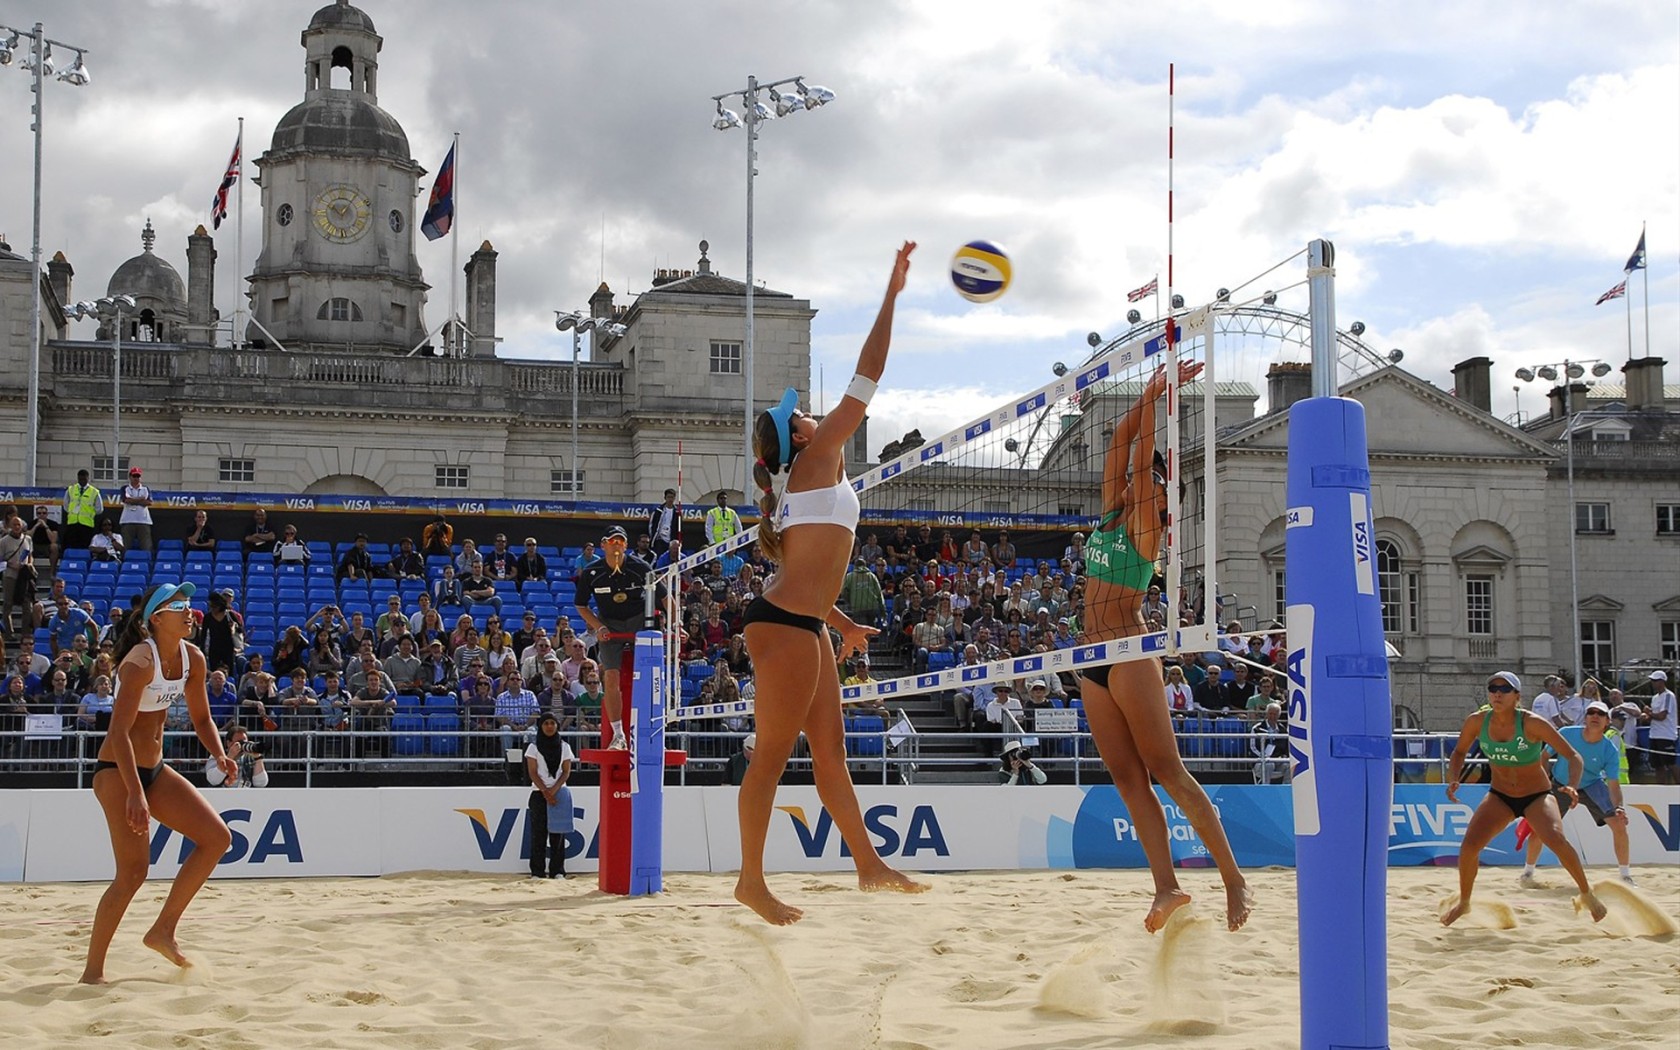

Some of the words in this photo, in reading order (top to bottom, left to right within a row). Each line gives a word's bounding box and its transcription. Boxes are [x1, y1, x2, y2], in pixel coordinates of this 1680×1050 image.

[1087, 370, 1099, 382] VISA
[0, 491, 14, 502] SA
[166, 496, 197, 507] VISA
[286, 498, 315, 510] VISA
[342, 499, 371, 511] VISA
[457, 502, 486, 514] VISA
[512, 504, 540, 515] VISA
[622, 507, 650, 519] VISA
[938, 515, 963, 526] VISA
[988, 517, 1013, 527] VISA
[1355, 522, 1369, 566] VISA
[1086, 547, 1110, 568] VISA
[1084, 649, 1095, 660] VISA
[1288, 647, 1310, 779] VISA
[1516, 736, 1524, 745] 2
[1488, 754, 1519, 762] VISA
[1389, 804, 1474, 836] FIVB
